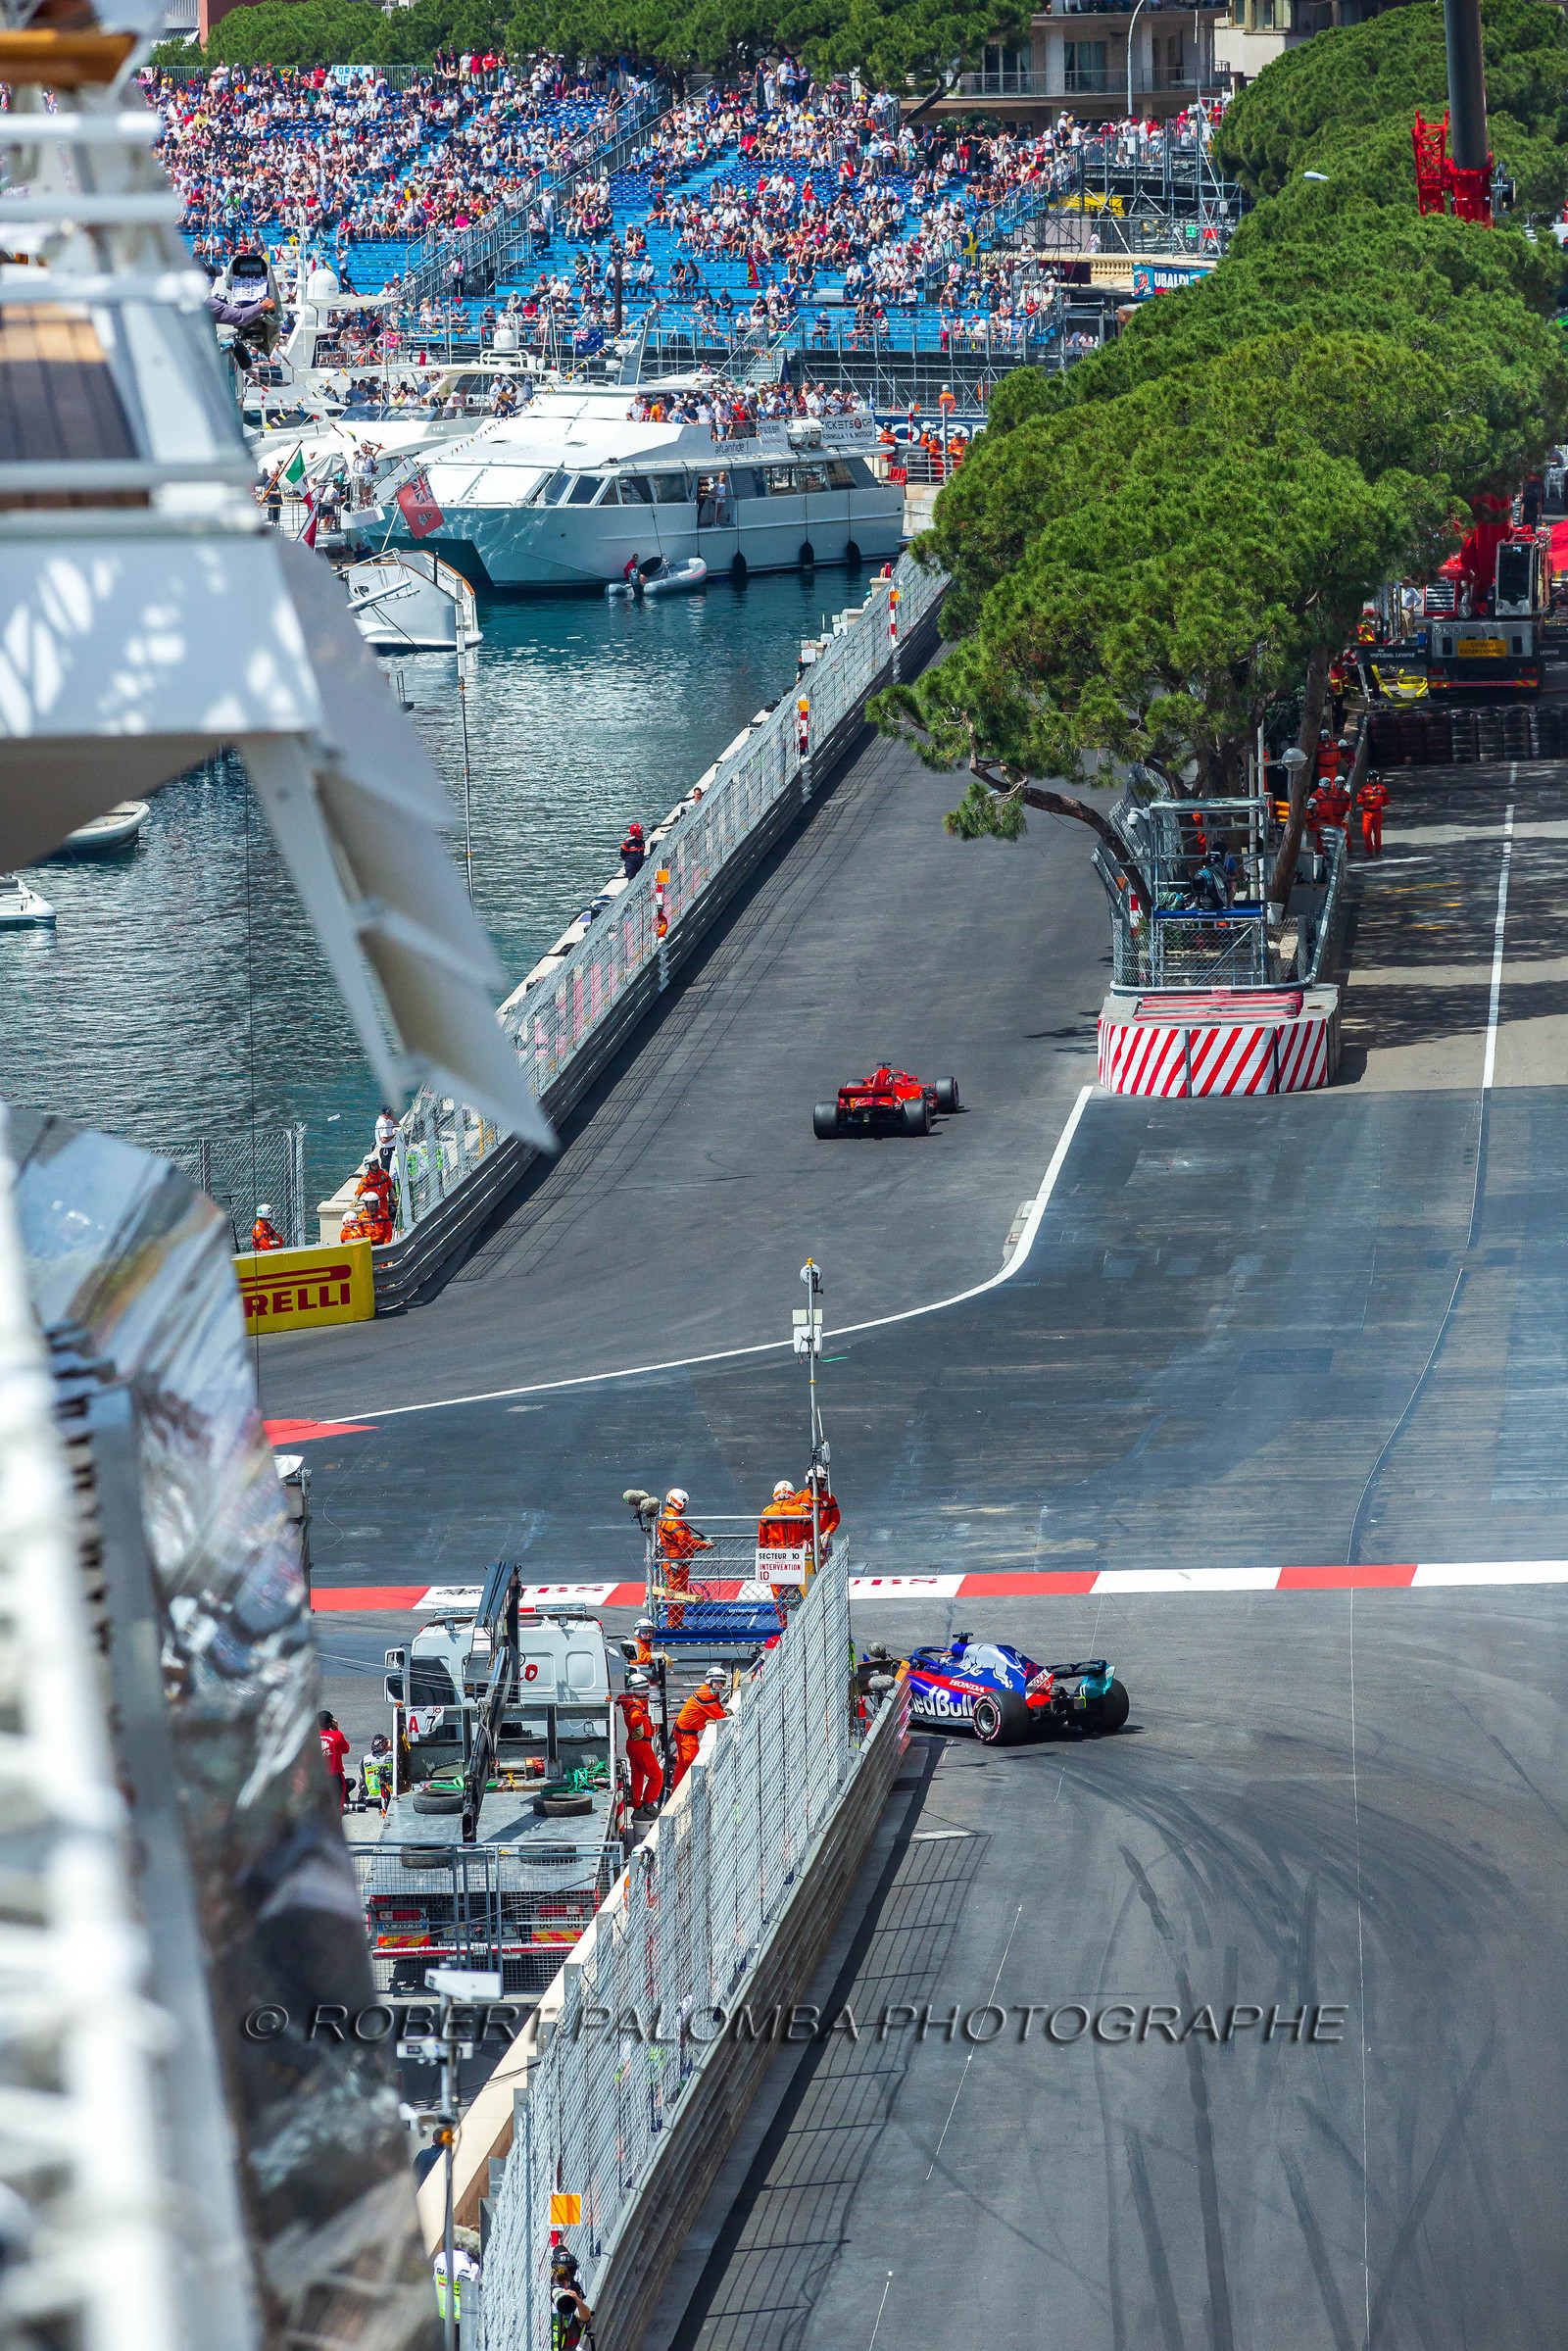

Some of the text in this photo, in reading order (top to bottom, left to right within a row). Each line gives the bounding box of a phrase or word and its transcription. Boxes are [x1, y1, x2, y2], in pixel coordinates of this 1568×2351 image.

[715, 443, 744, 454] atlantide
[760, 1571, 769, 1580] 10
[949, 1679, 985, 1693] HONDA
[409, 1716, 419, 1733] A
